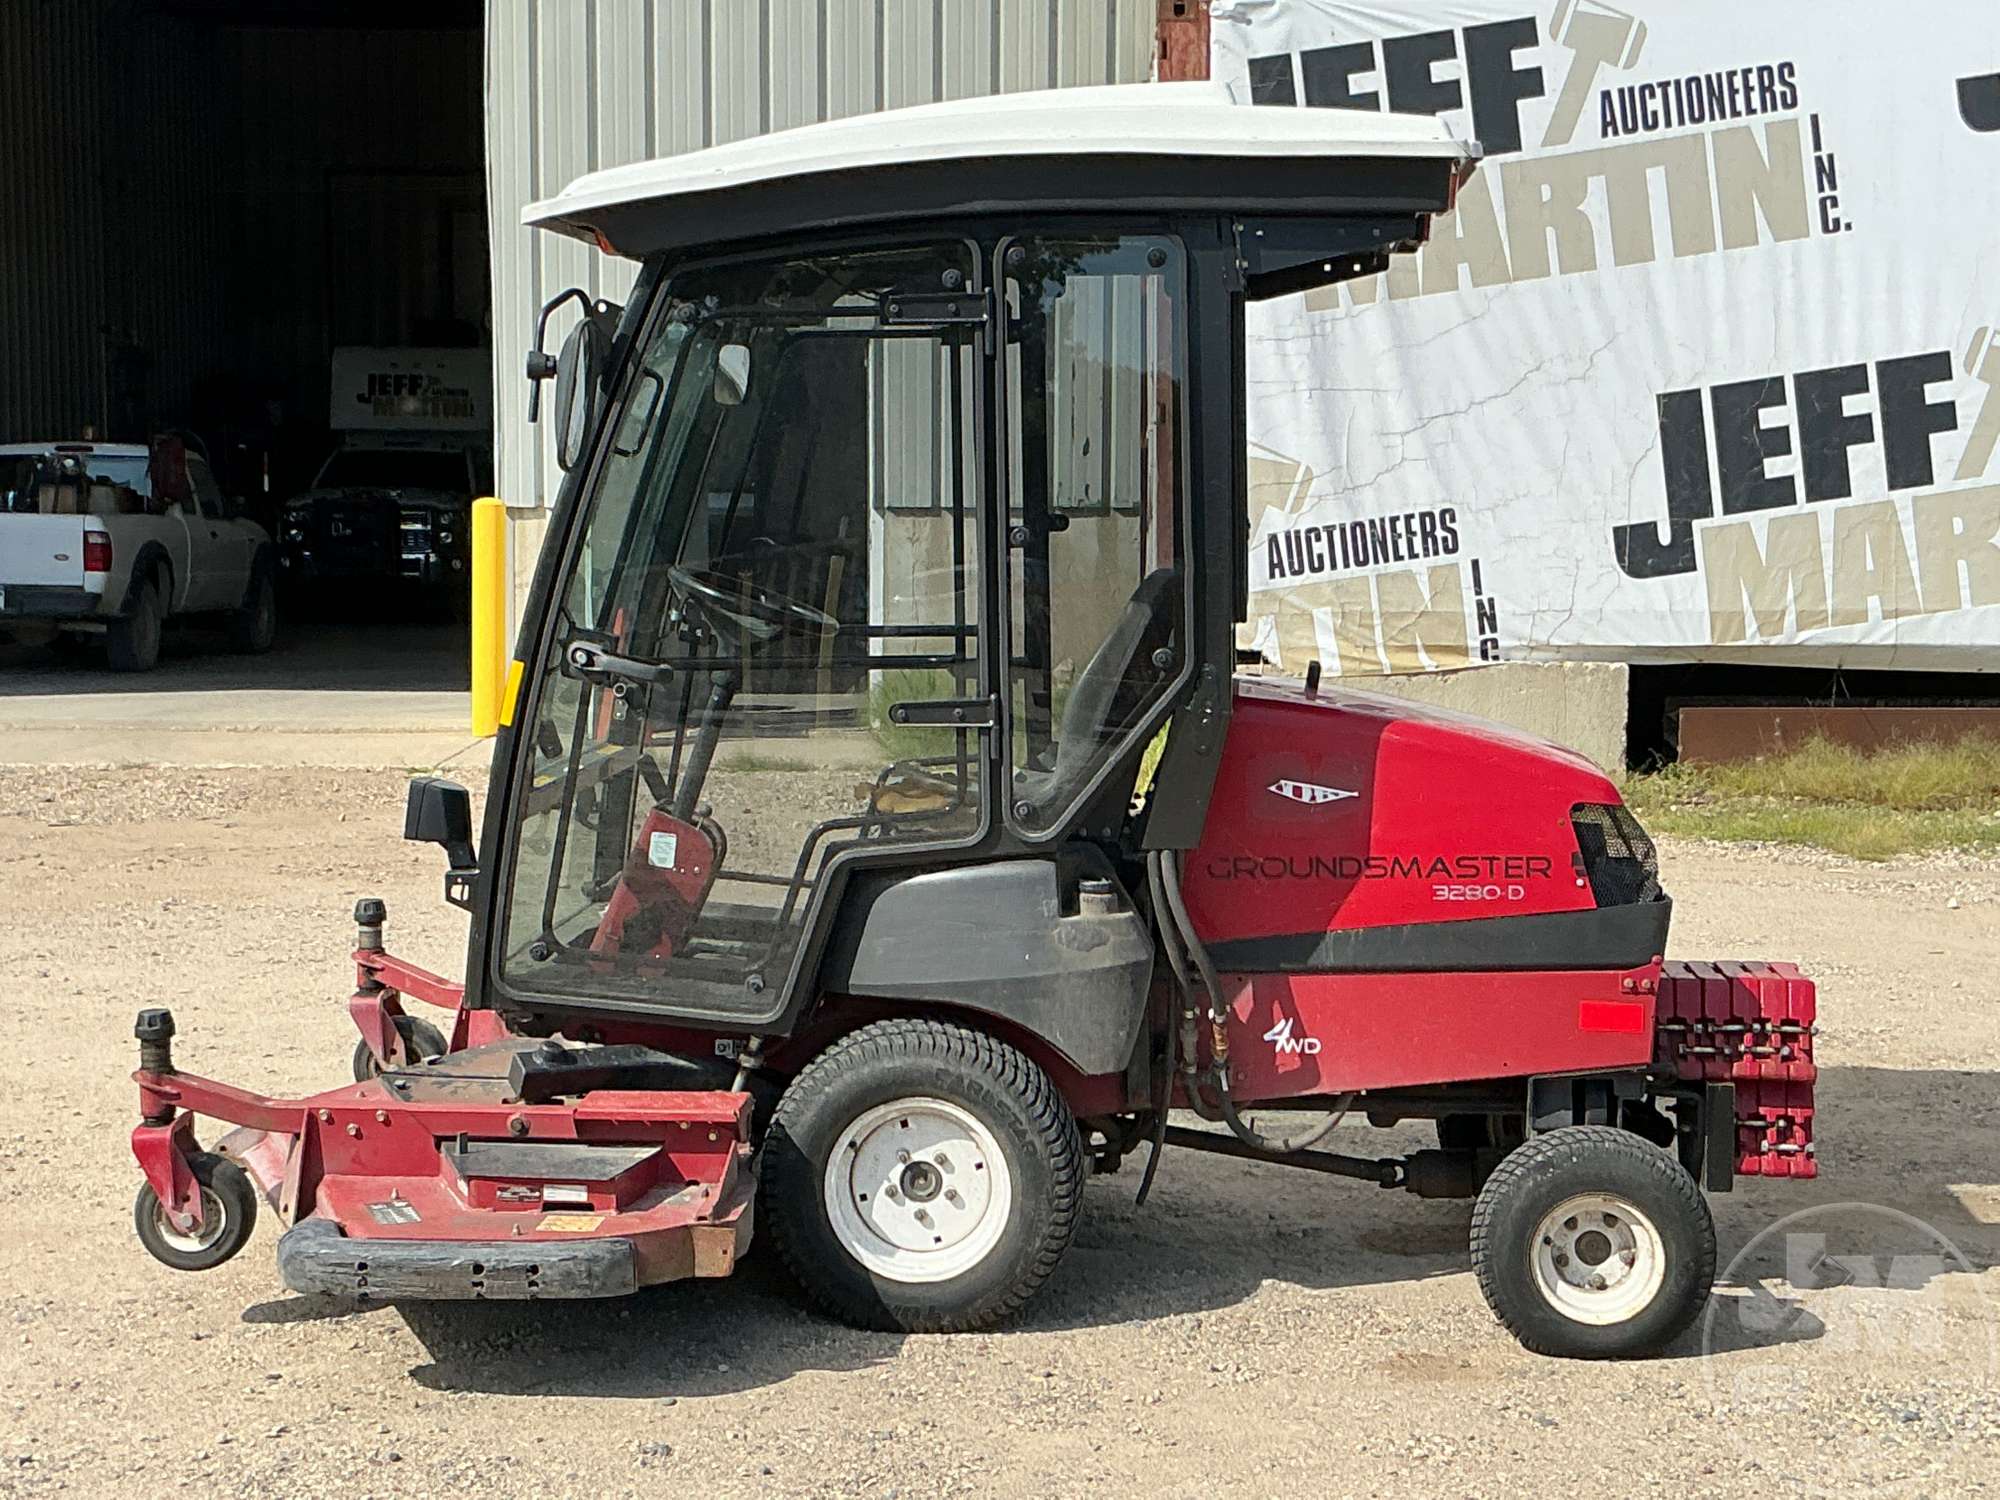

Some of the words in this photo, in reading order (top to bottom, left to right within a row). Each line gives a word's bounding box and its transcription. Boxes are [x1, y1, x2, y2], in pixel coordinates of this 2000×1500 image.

[1599, 62, 1798, 138] AUCTIONEERS
[1302, 119, 1809, 313] ARTIN
[356, 373, 424, 404] JEFF
[1613, 350, 1958, 579] JEFF
[1267, 507, 1460, 580] AUCTIONEERS
[1206, 856, 1553, 880] GROUNDSMASTER
[1263, 1017, 1322, 1055] 4WD
